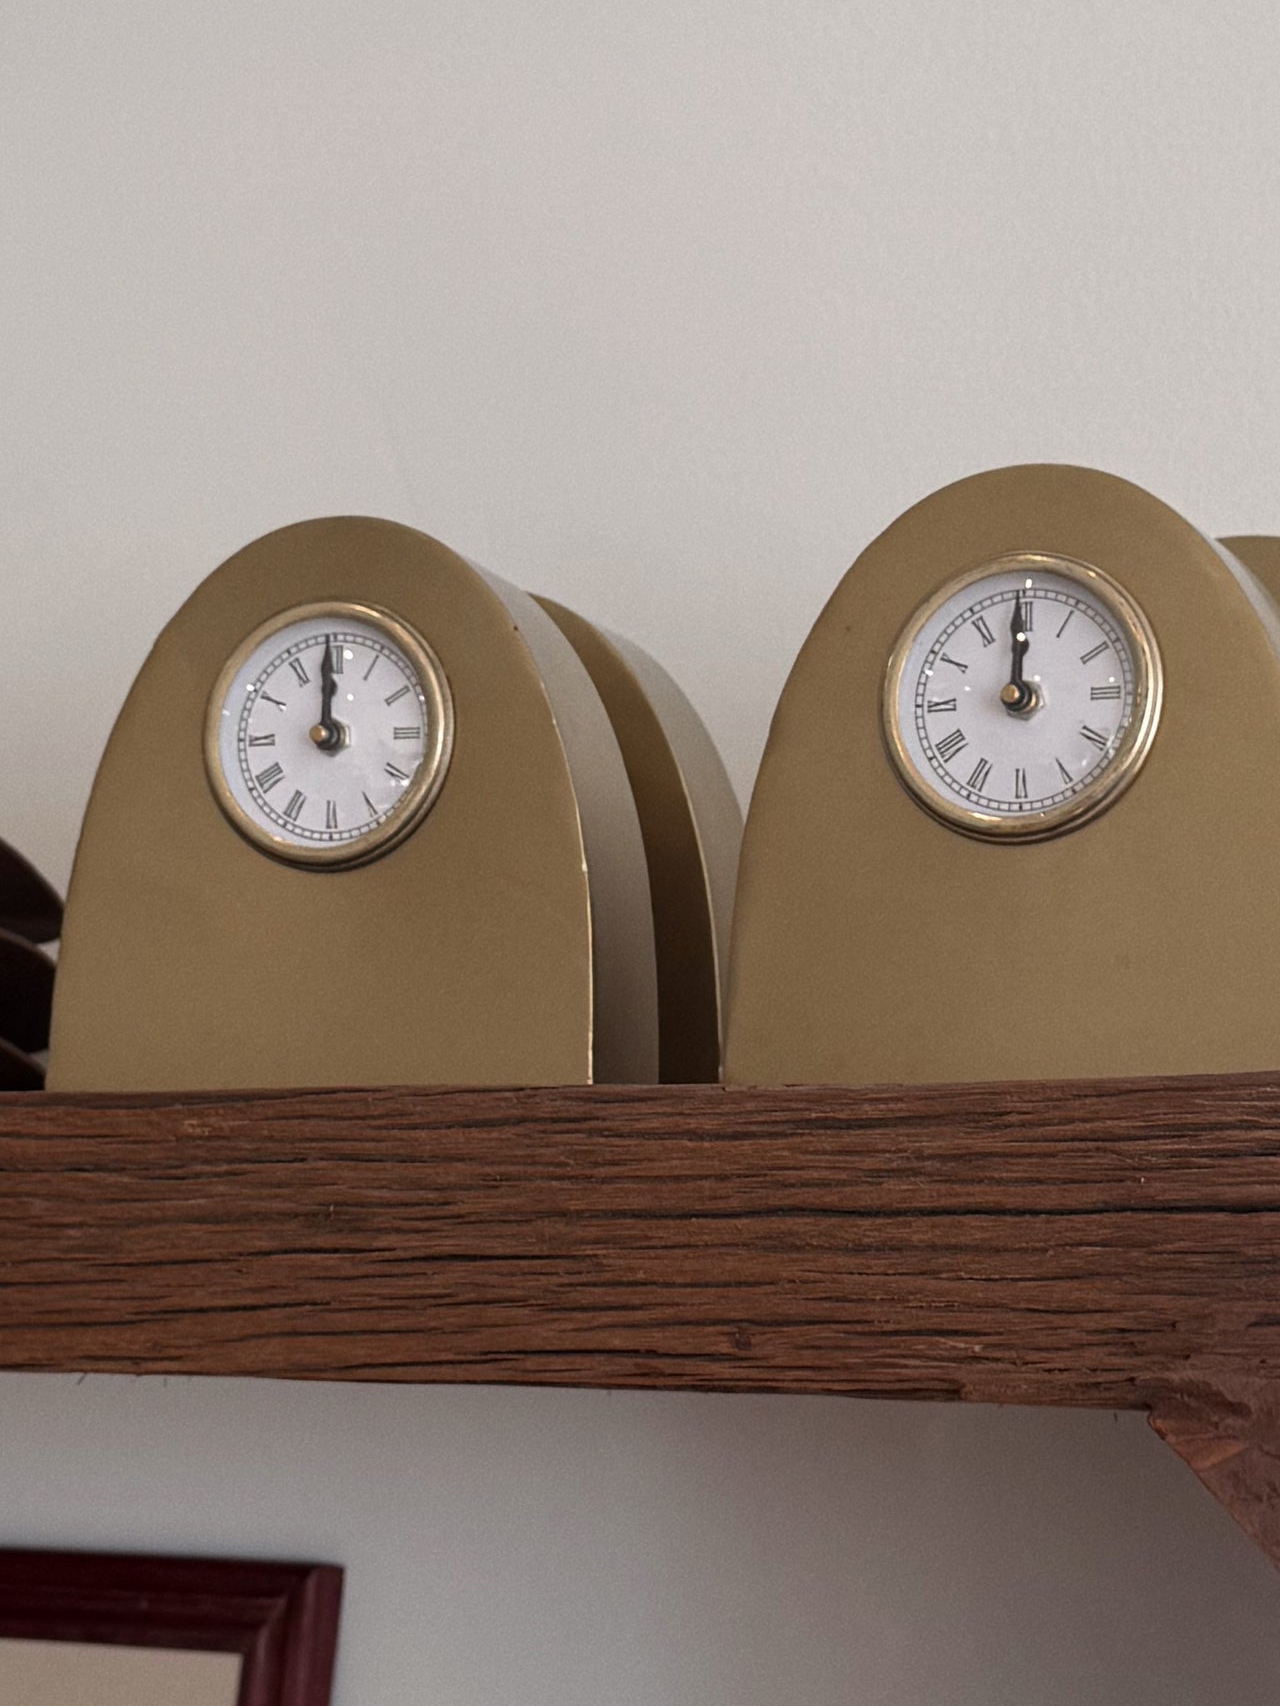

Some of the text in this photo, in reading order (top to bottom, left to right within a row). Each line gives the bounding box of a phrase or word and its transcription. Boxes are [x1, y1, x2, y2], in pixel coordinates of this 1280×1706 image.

[972, 615, 995, 648] XI
[1056, 610, 1075, 638] I
[940, 653, 968, 674] X
[1080, 641, 1109, 665] II
[289, 658, 311, 688] XI
[363, 654, 379, 681] I
[260, 691, 287, 712] X
[384, 685, 410, 706] II
[927, 698, 956, 713] IX
[1091, 686, 1120, 701] III
[248, 734, 275, 747] IX
[393, 727, 420, 740] III
[935, 728, 969, 763] VIII
[1080, 725, 1109, 751] IV
[255, 762, 285, 794] VIII
[967, 757, 992, 792] VII
[1015, 768, 1027, 799] VI
[1055, 757, 1073, 784] V
[283, 789, 307, 822] VII
[326, 800, 338, 829] VI
